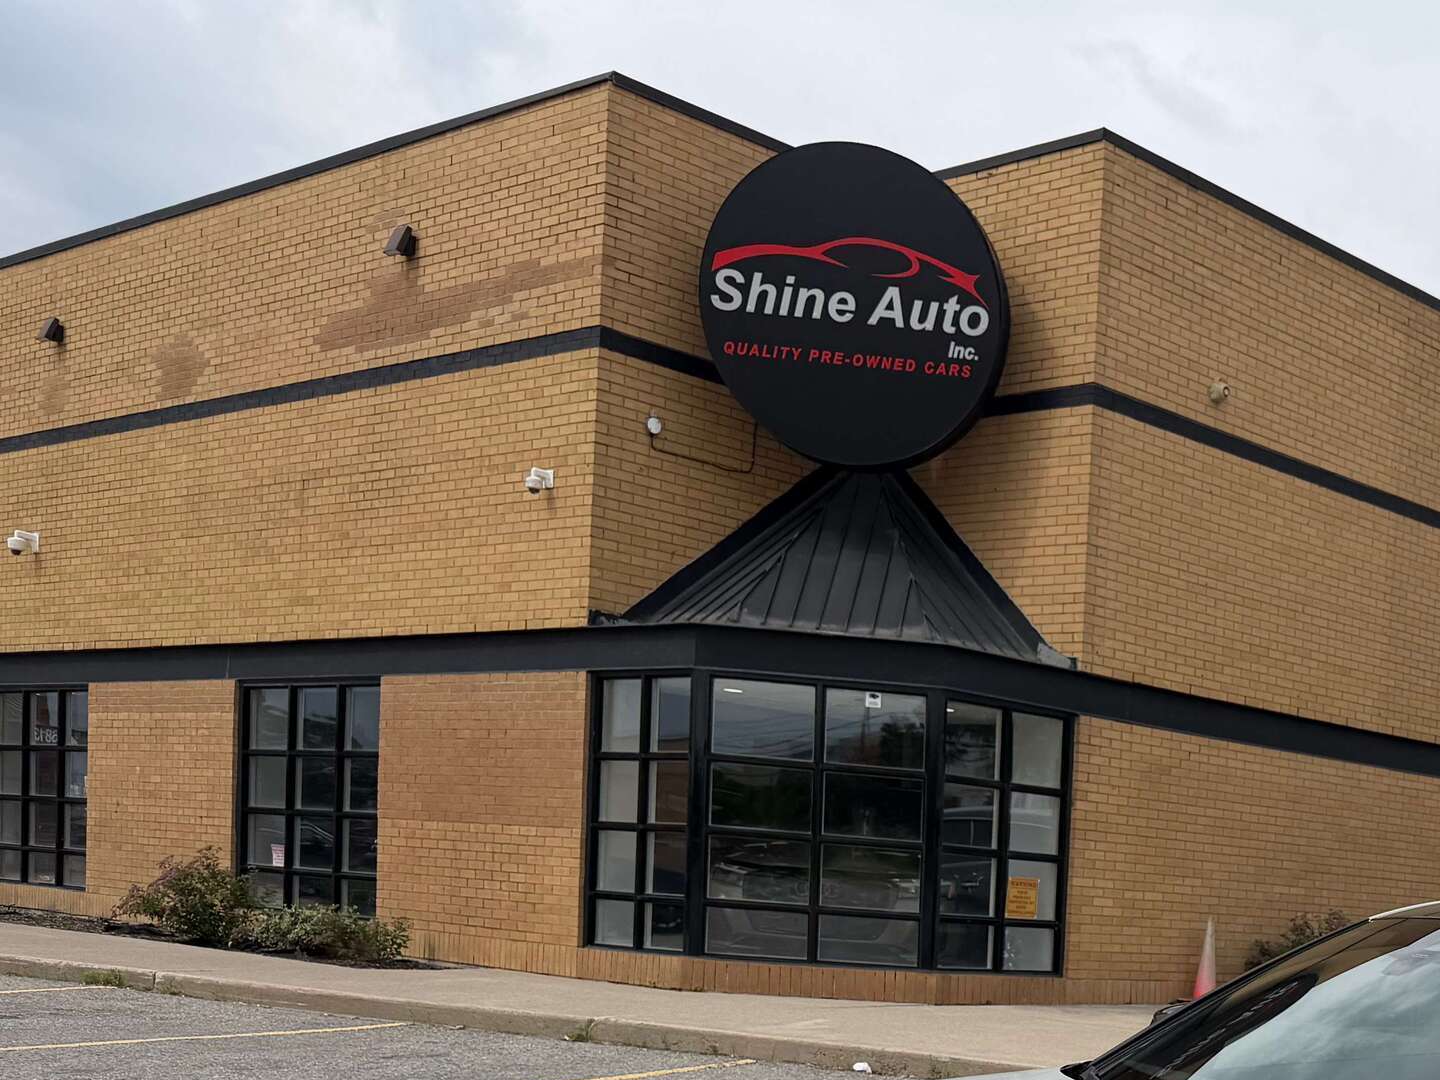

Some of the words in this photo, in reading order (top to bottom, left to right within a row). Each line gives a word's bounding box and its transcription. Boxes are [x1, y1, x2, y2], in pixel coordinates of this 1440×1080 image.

[710, 268, 856, 323] Shine
[867, 285, 990, 337] Auto
[723, 341, 802, 360] QUALITY
[808, 350, 917, 374] PRE-OWNED
[924, 360, 972, 379] CARS
[947, 341, 979, 361] Inc.
